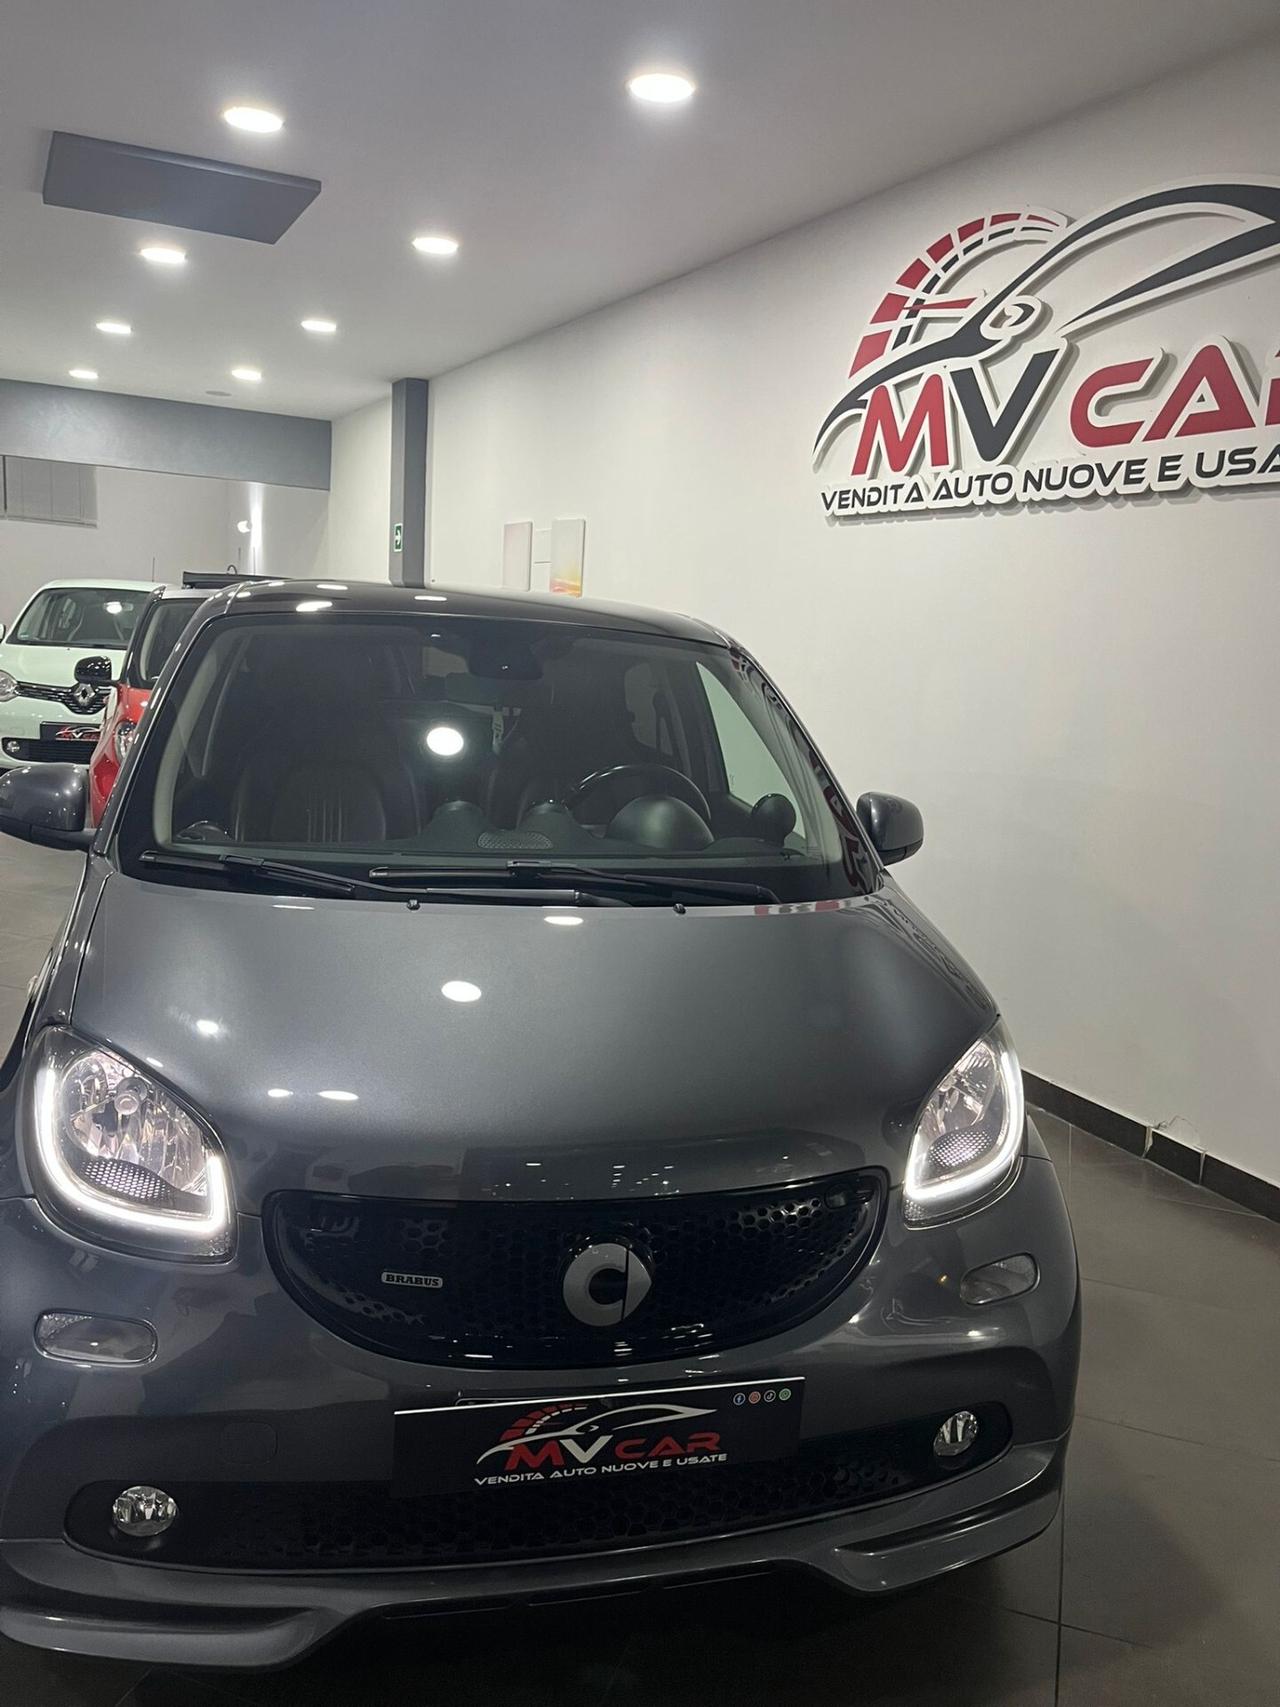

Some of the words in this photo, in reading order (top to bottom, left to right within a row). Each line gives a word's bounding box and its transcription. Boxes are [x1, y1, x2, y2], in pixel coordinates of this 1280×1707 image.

[851, 349, 1060, 476] MV
[1070, 344, 1280, 448] CA
[821, 484, 923, 511] VENDITA
[933, 471, 1013, 500] AUTO
[1022, 459, 1146, 493] NUOVE
[1157, 454, 1184, 482] E
[386, 1274, 439, 1286] BRABUS
[474, 1472, 545, 1486] VENDITA
[550, 1466, 597, 1478] AUTO
[601, 1460, 659, 1473] NUOVE
[662, 1459, 673, 1467] E
[676, 1453, 728, 1465] USATE
[505, 1435, 614, 1470] MV
[615, 1431, 721, 1459] CAR
